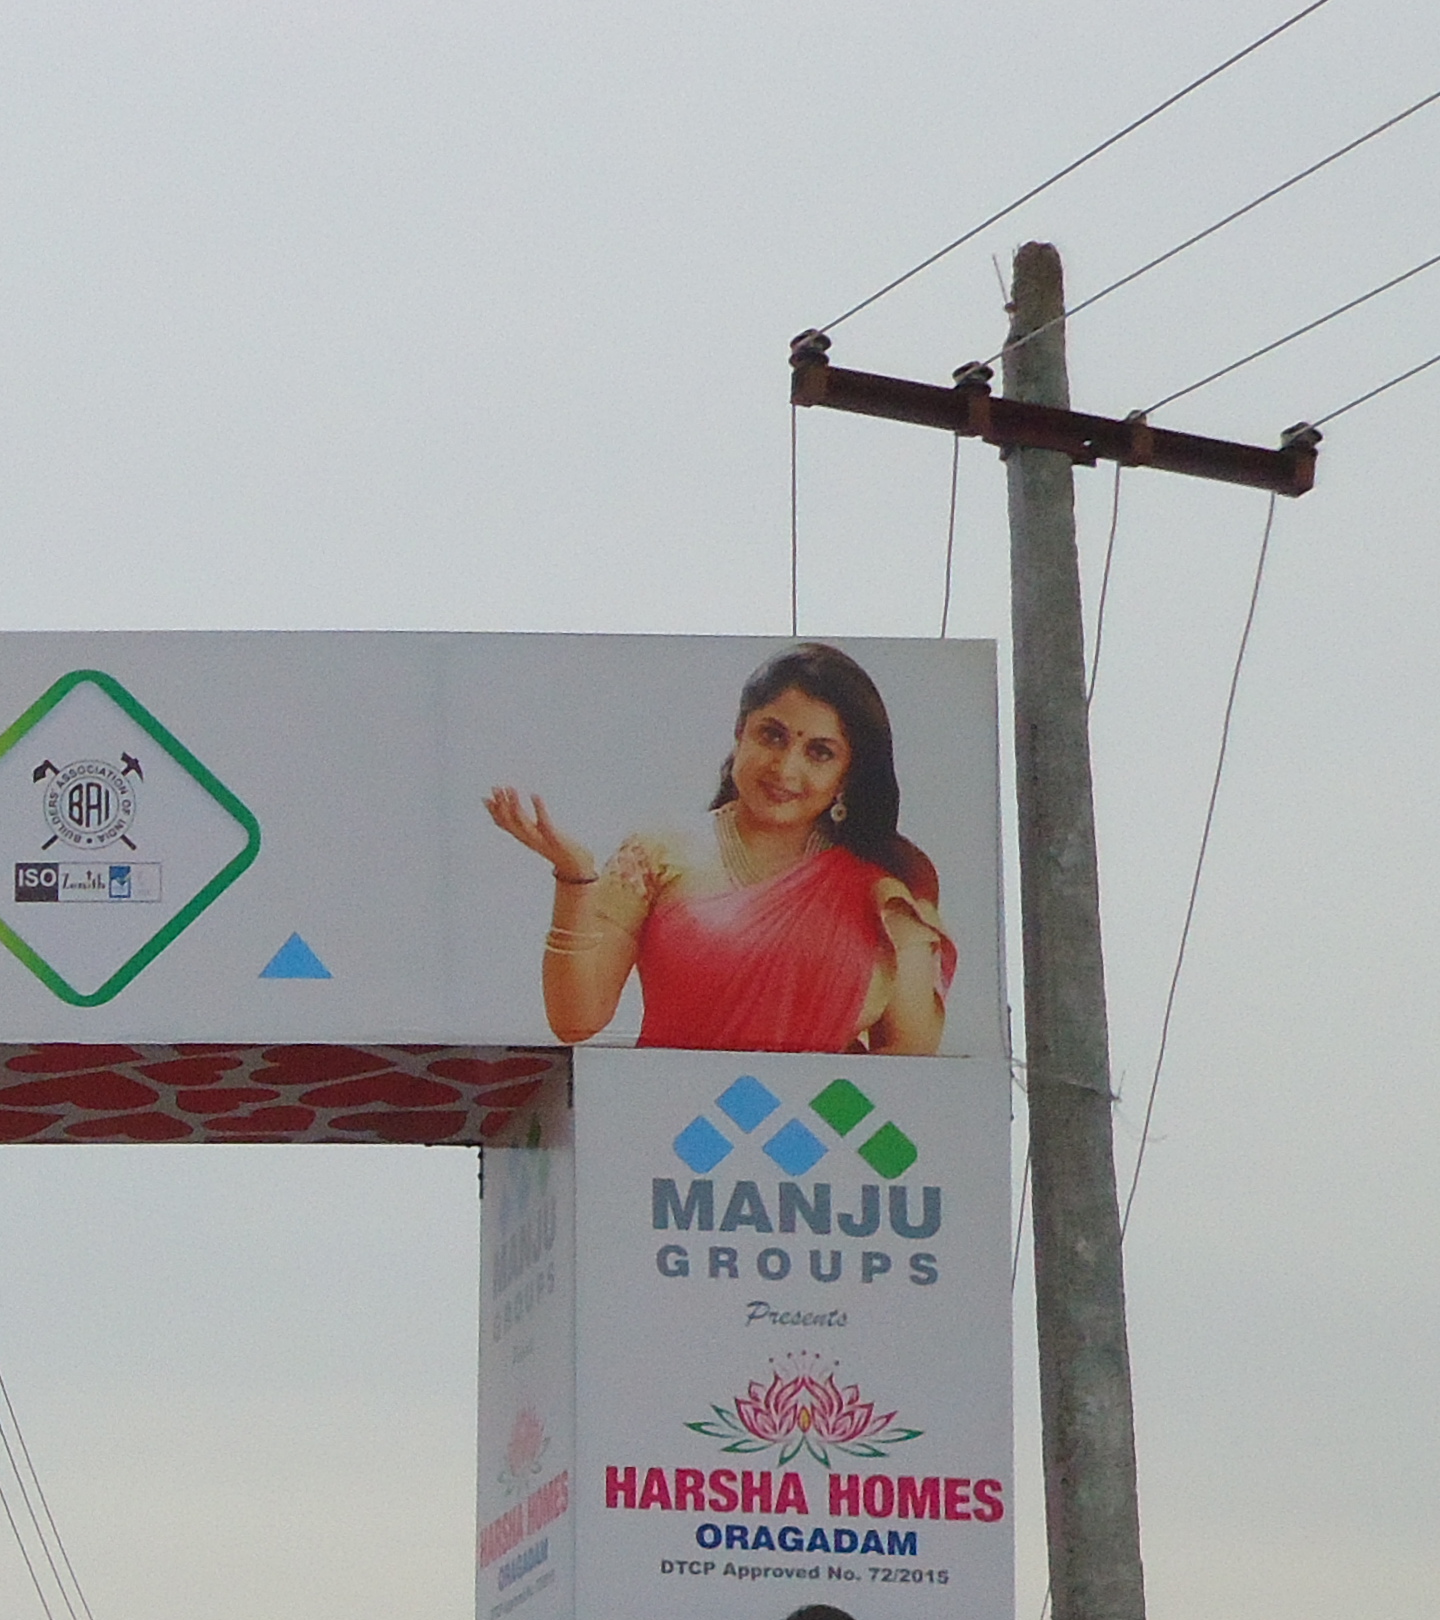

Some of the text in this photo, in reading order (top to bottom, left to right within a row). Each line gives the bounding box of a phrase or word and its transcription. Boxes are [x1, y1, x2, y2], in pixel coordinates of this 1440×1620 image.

[56, 765, 130, 795] ASSOCIATION
[69, 782, 110, 829] BAI
[122, 799, 132, 816] OF
[98, 819, 127, 843] INDIA
[19, 868, 57, 888] ISO
[652, 1178, 942, 1239] MANJU
[656, 1244, 939, 1286] GROUPS
[745, 1300, 847, 1328] Presents
[605, 1466, 809, 1515] HARSHA
[828, 1473, 1004, 1522] HOMES
[696, 1523, 918, 1556] ORAGADAM
[660, 1560, 949, 1585] DTCP Approved No. 72/2015
